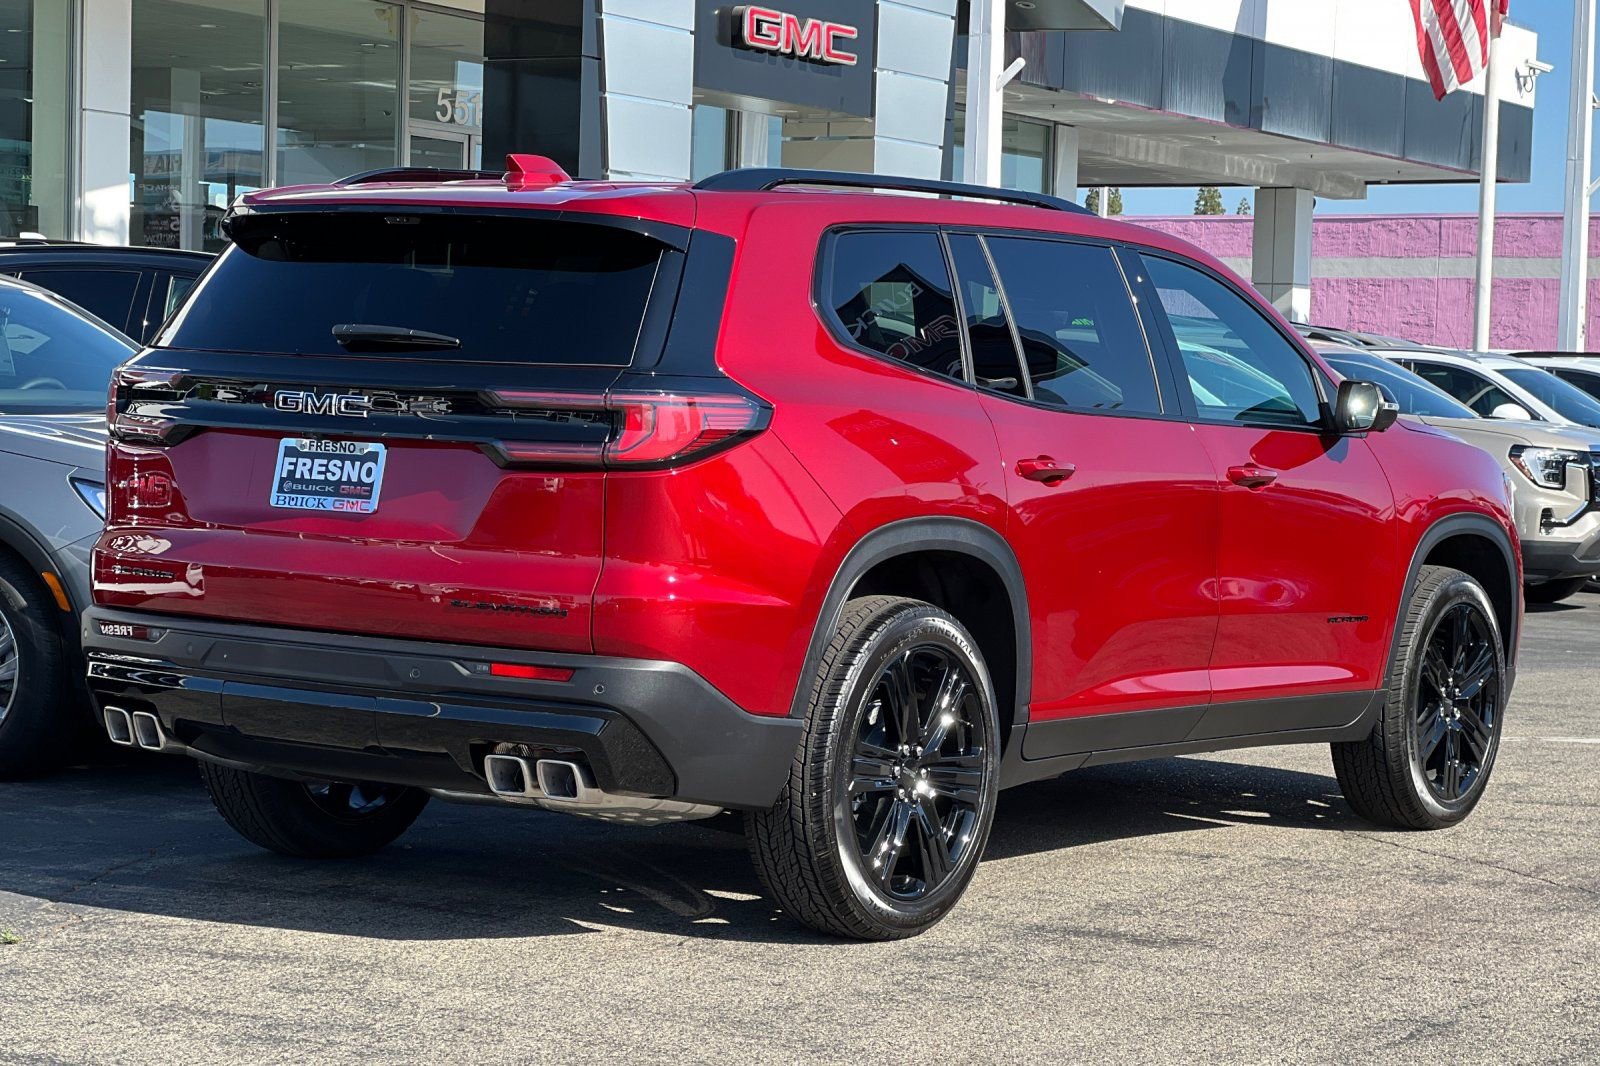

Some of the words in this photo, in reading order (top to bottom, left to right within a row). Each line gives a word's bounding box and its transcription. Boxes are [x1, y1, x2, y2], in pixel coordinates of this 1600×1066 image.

[743, 5, 858, 66] GMC
[274, 390, 369, 418] GMC
[308, 440, 357, 453] FRESNO
[281, 457, 378, 484] FRESNO
[292, 484, 335, 493] BUICK
[339, 485, 371, 496] GMC
[276, 495, 329, 509] BUICK
[332, 498, 371, 512] GMC
